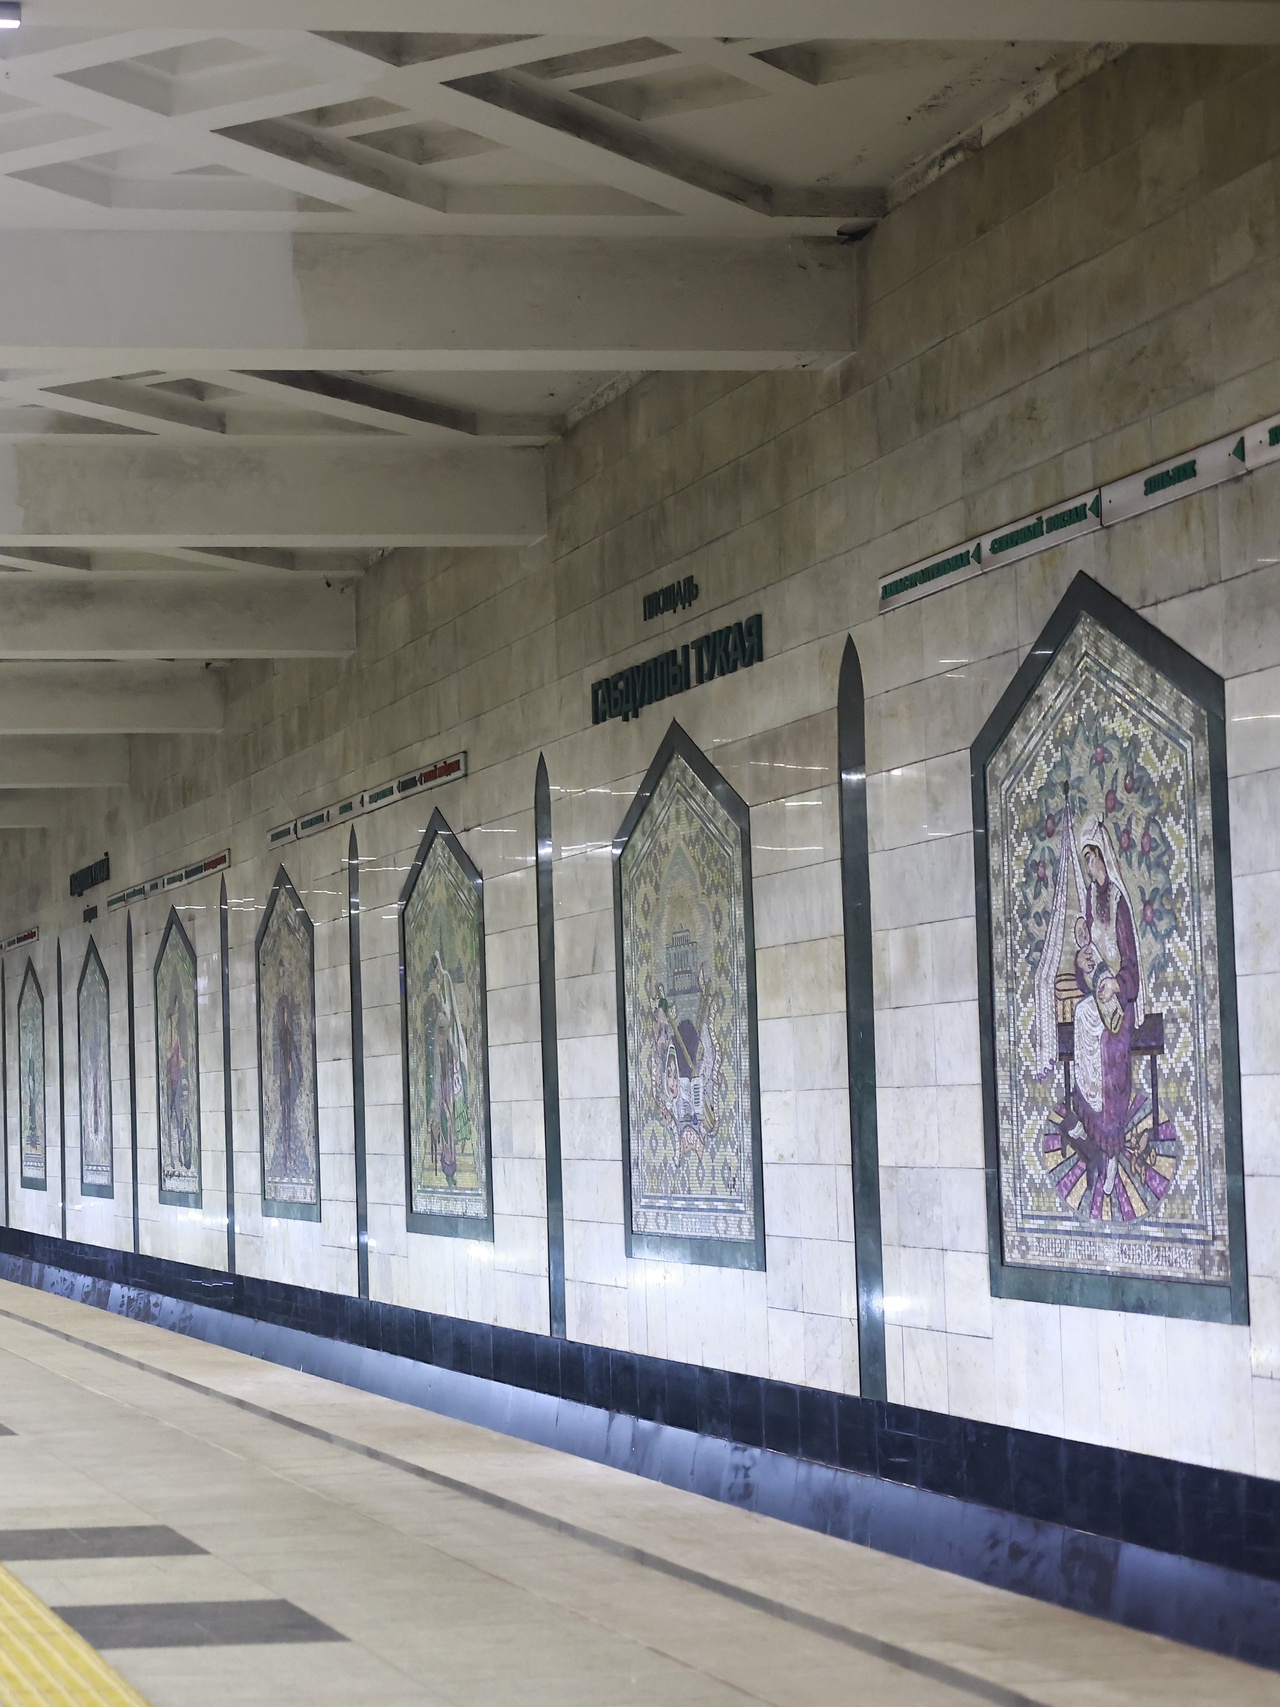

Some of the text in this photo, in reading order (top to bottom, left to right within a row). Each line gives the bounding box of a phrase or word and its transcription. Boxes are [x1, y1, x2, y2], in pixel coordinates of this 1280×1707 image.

[643, 575, 699, 621] ПЛОЩАДЬ
[591, 613, 764, 725] ГАБДУЛЛЫ ТУКАЯ
